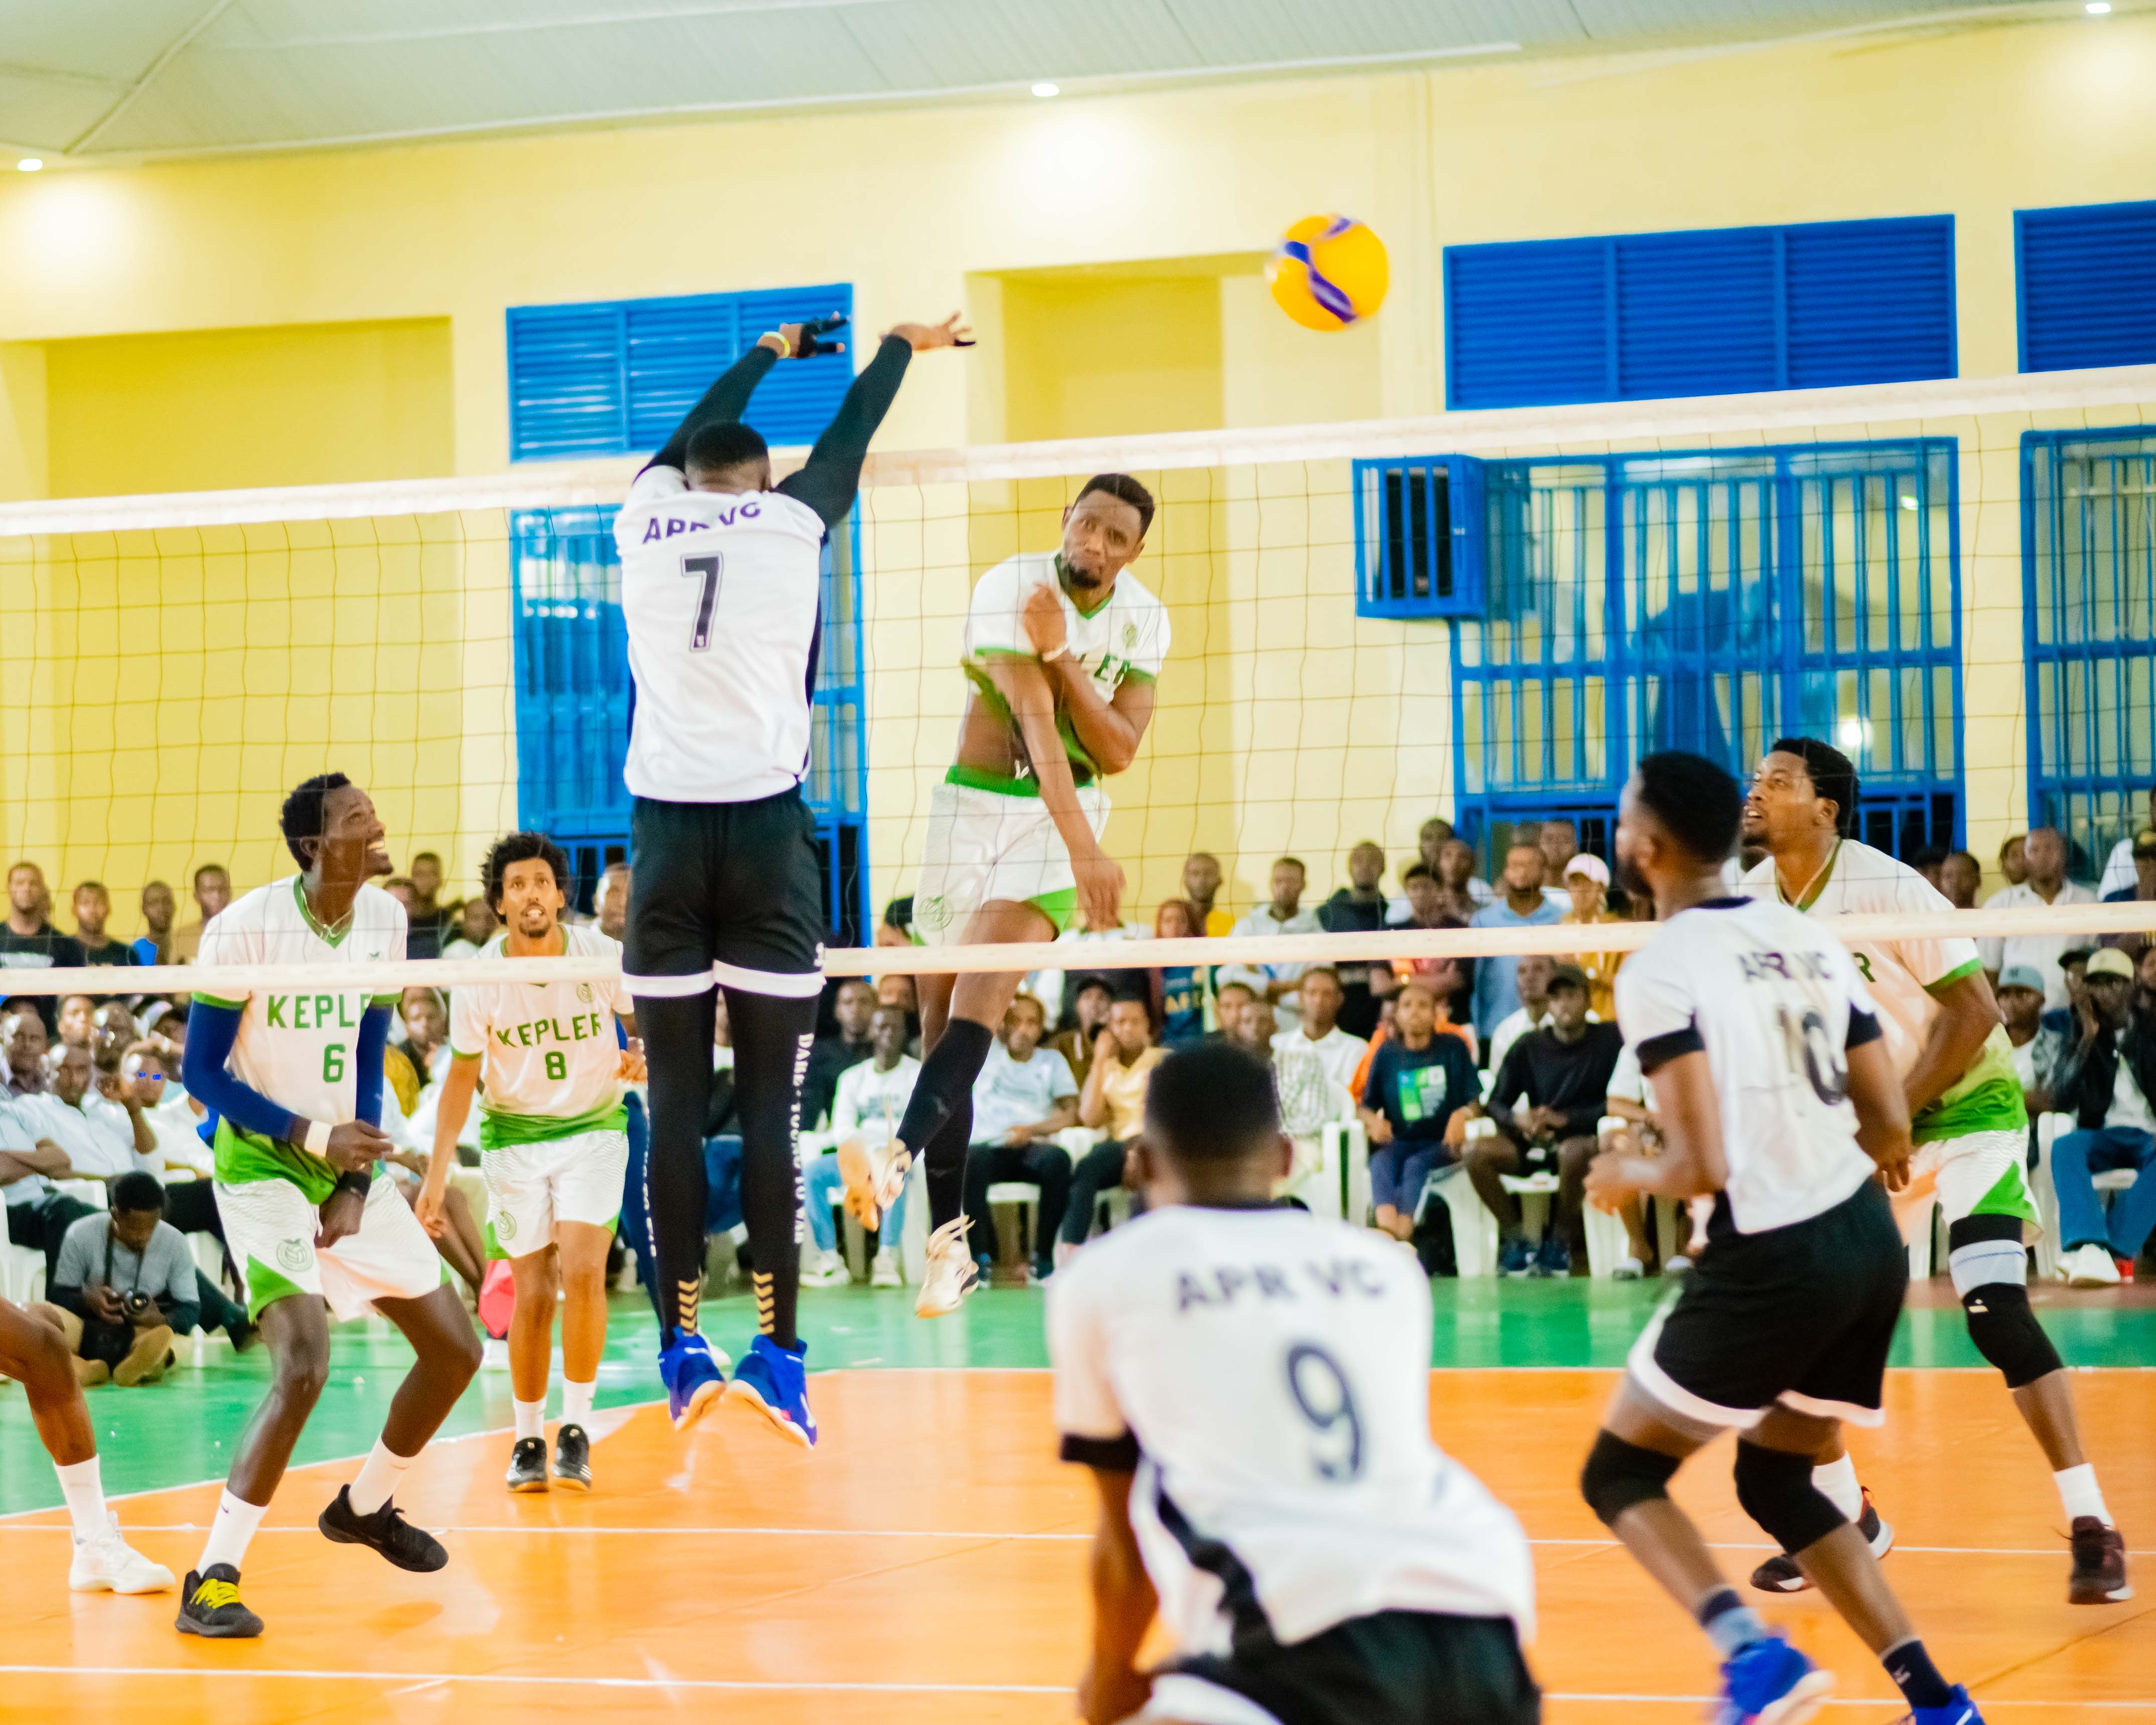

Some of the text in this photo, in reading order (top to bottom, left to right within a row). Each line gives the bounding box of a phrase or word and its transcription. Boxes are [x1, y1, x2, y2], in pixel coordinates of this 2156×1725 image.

[682, 552, 723, 652] 7
[323, 1044, 345, 1082] 6
[545, 1051, 566, 1080] 8
[1177, 1254, 1386, 1315] APR VC
[1284, 1339, 1364, 1483] 9
